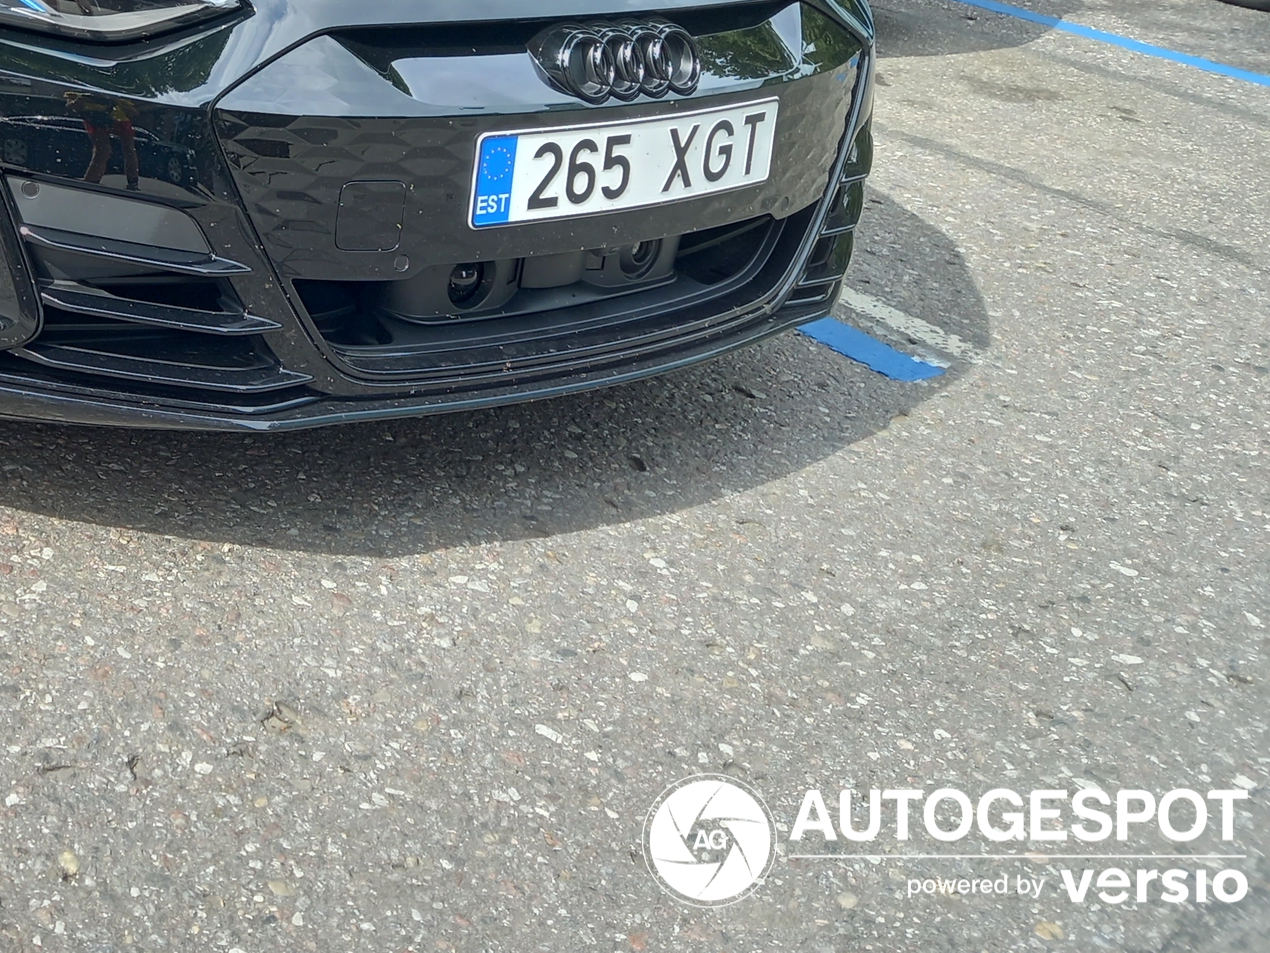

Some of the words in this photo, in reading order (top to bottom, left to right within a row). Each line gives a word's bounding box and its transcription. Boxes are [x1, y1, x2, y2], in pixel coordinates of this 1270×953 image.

[527, 134, 632, 210] 265
[661, 112, 766, 193] XGT
[476, 193, 509, 215] EST
